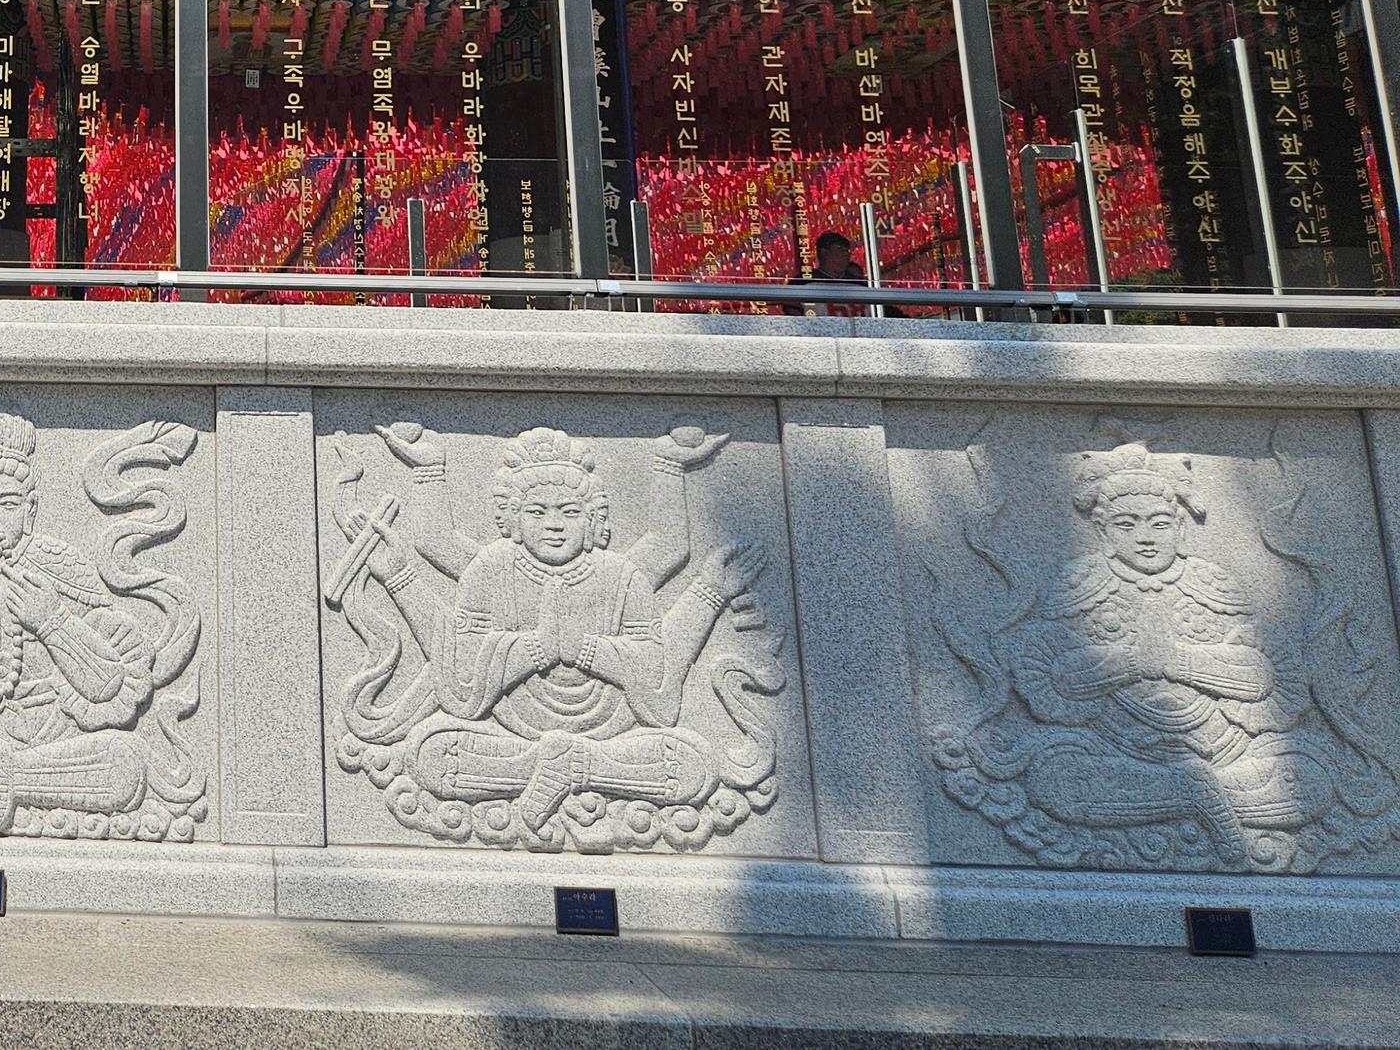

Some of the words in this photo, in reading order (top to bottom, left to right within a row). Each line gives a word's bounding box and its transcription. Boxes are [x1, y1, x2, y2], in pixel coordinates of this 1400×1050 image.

[78, 36, 101, 221] 승열바라자행녀
[283, 38, 306, 225] 구족우바명지사
[372, 40, 398, 228] 무염족왕대광왕
[670, 45, 703, 234] 사자빈신바수밀
[855, 47, 897, 239] 바산바연주야신
[1075, 48, 1122, 241] 희목관찰중생신
[1170, 48, 1220, 243] 적정음해주야신
[1264, 49, 1318, 244] 개부수화주야신
